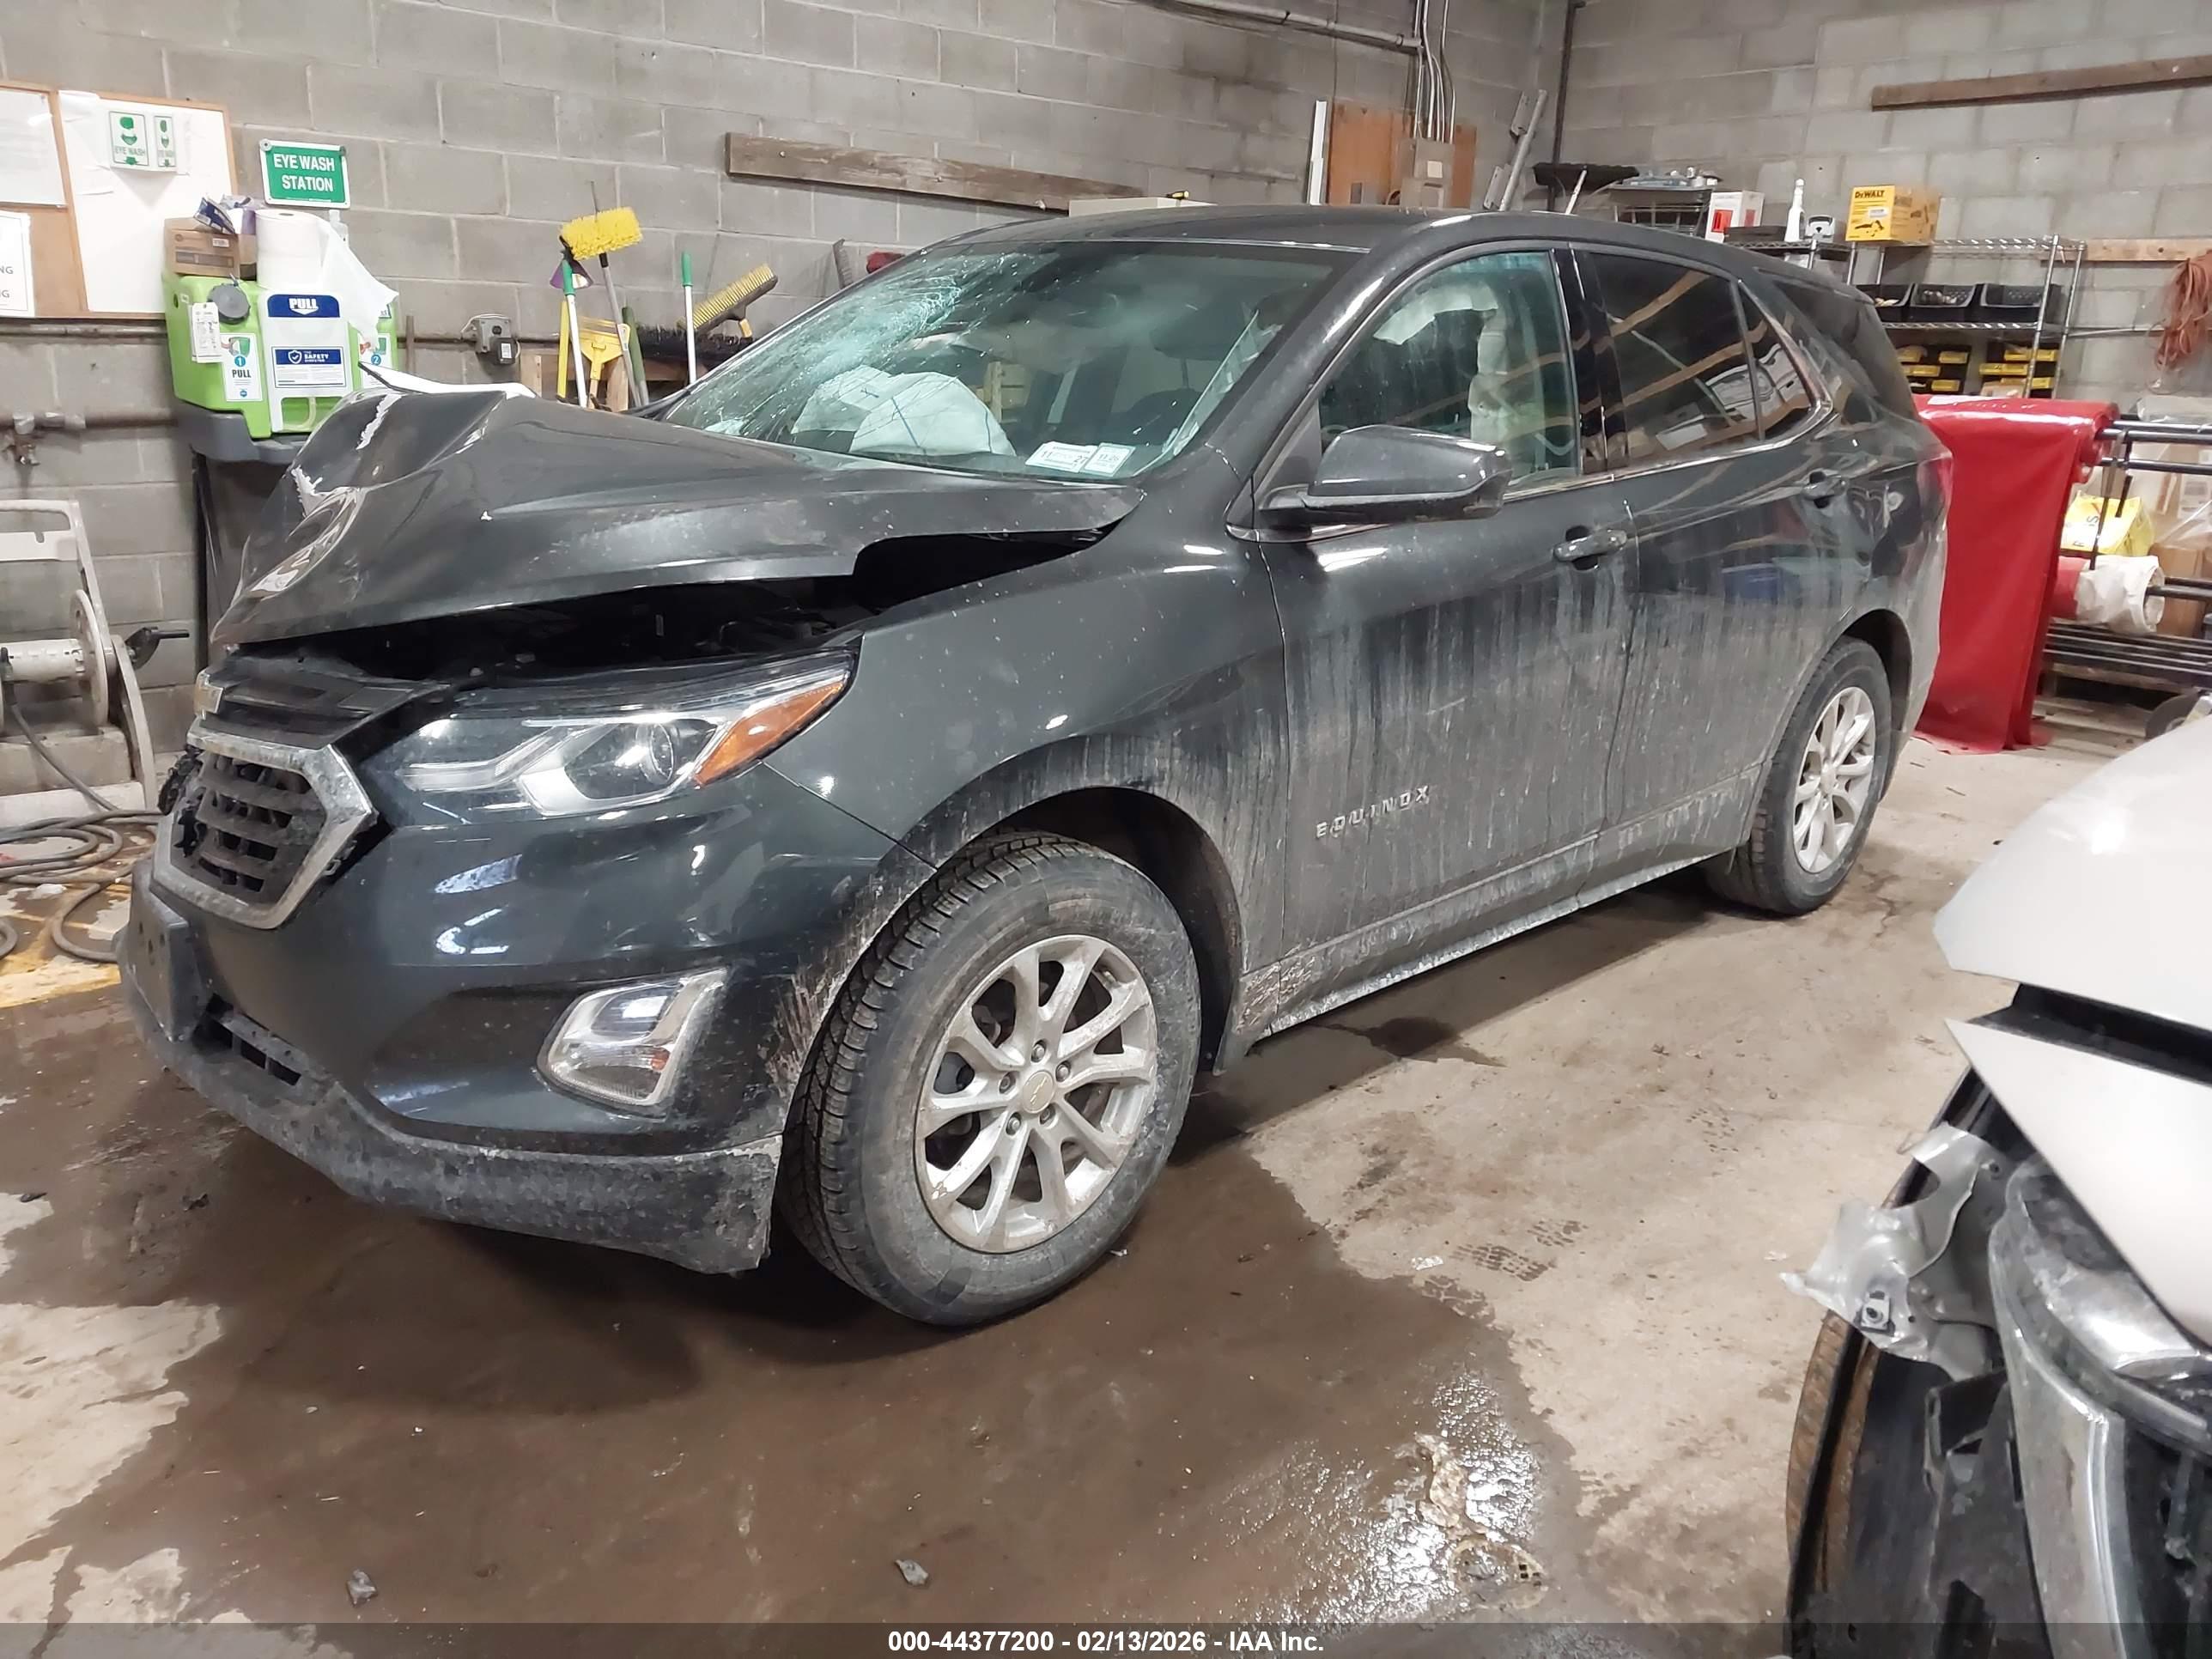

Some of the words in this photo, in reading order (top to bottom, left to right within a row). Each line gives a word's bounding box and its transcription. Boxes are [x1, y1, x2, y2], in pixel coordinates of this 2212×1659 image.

[273, 153, 299, 168] EYE
[298, 155, 335, 172] WASH
[282, 174, 334, 192] STATION
[289, 298, 319, 309] PULL
[232, 369, 252, 378] PULL
[1316, 785, 1430, 838] EQUINOX
